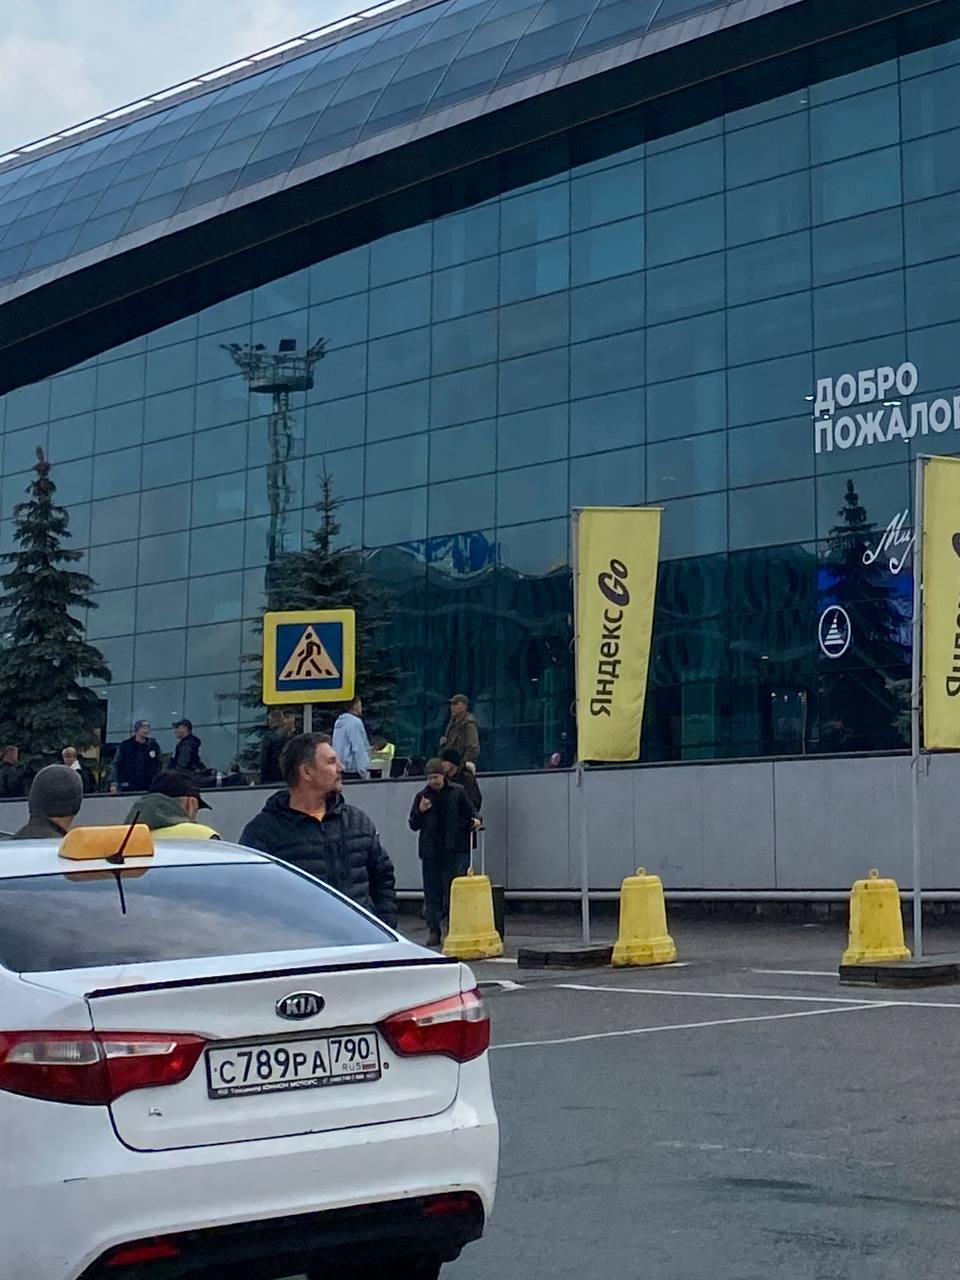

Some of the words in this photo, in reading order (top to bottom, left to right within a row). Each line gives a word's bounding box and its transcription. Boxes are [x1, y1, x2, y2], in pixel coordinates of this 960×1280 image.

[814, 361, 919, 417] ДОБРО
[597, 558, 631, 607] Go
[590, 608, 624, 718] Яндекс
[285, 996, 319, 1016] KIA
[330, 1037, 371, 1063] 790
